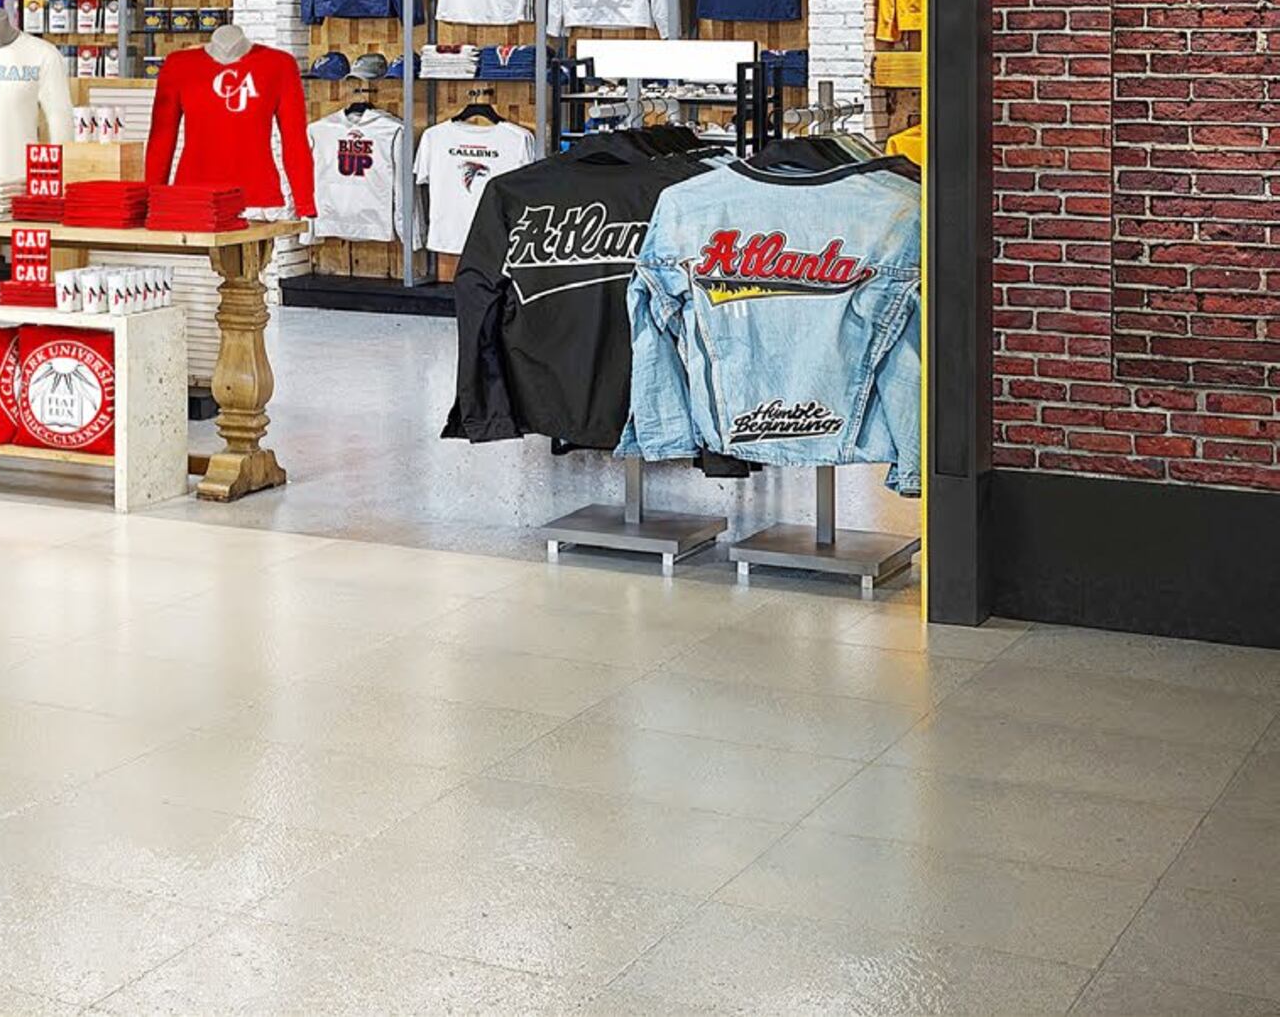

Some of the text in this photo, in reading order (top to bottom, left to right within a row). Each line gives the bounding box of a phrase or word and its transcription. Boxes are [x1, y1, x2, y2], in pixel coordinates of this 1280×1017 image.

[30, 146, 59, 163] CAU
[339, 139, 373, 154] RISE
[338, 154, 373, 176] UP
[30, 179, 59, 196] CAU
[16, 231, 48, 247] CAU
[510, 204, 648, 263] Atlan
[695, 230, 876, 284] Atlanta
[16, 265, 48, 282] CAU
[752, 400, 830, 419] Humble
[734, 416, 842, 435] Beginnings
